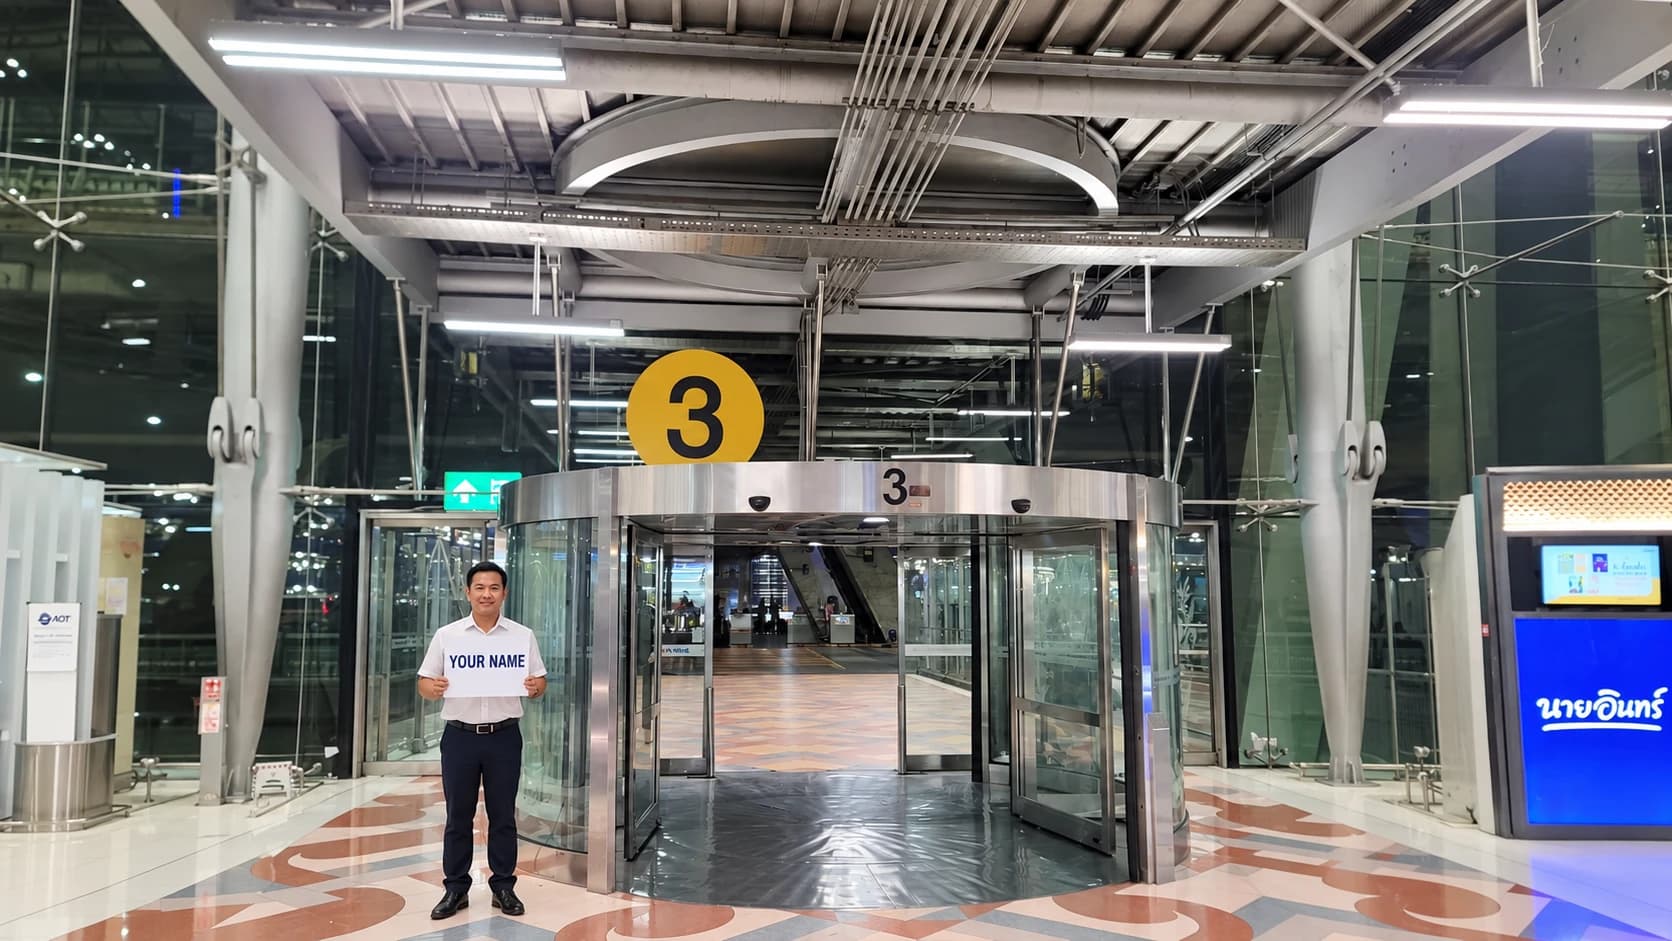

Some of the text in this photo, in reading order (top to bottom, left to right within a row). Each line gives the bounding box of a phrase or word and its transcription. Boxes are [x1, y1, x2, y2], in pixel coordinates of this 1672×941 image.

[667, 375, 724, 460] 3
[883, 468, 908, 505] 3
[52, 615, 71, 623] AOT
[449, 654, 526, 669] YOUR NAME
[1536, 686, 1669, 721] นายอินทร์
